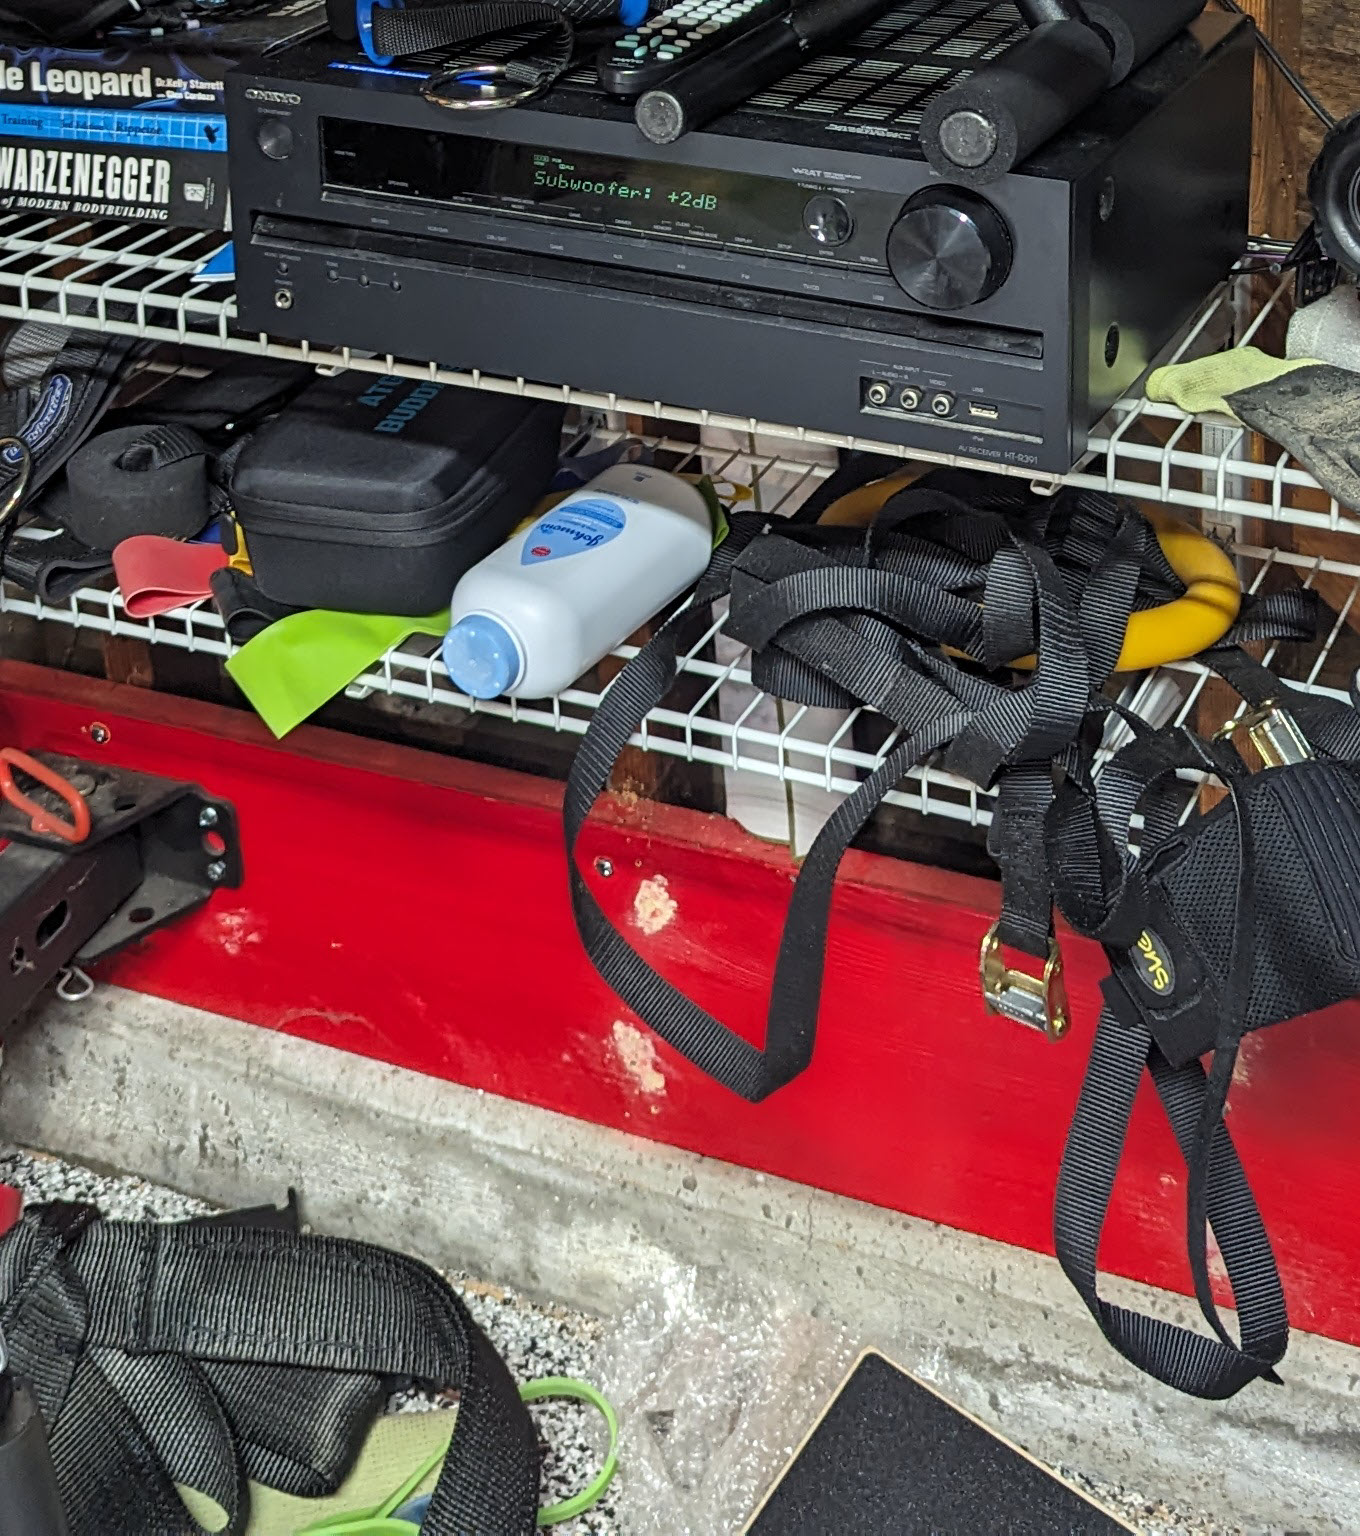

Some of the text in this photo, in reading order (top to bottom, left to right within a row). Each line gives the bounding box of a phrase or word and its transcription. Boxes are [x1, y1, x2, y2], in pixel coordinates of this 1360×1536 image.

[30, 61, 153, 101] Leopard
[244, 88, 301, 105] ONKYO
[1, 113, 44, 131] Training
[533, 170, 719, 211] Subwoofer: +2dB
[2, 195, 14, 208] of
[17, 197, 71, 212] MODERN
[73, 201, 170, 221] BODYBUILDING
